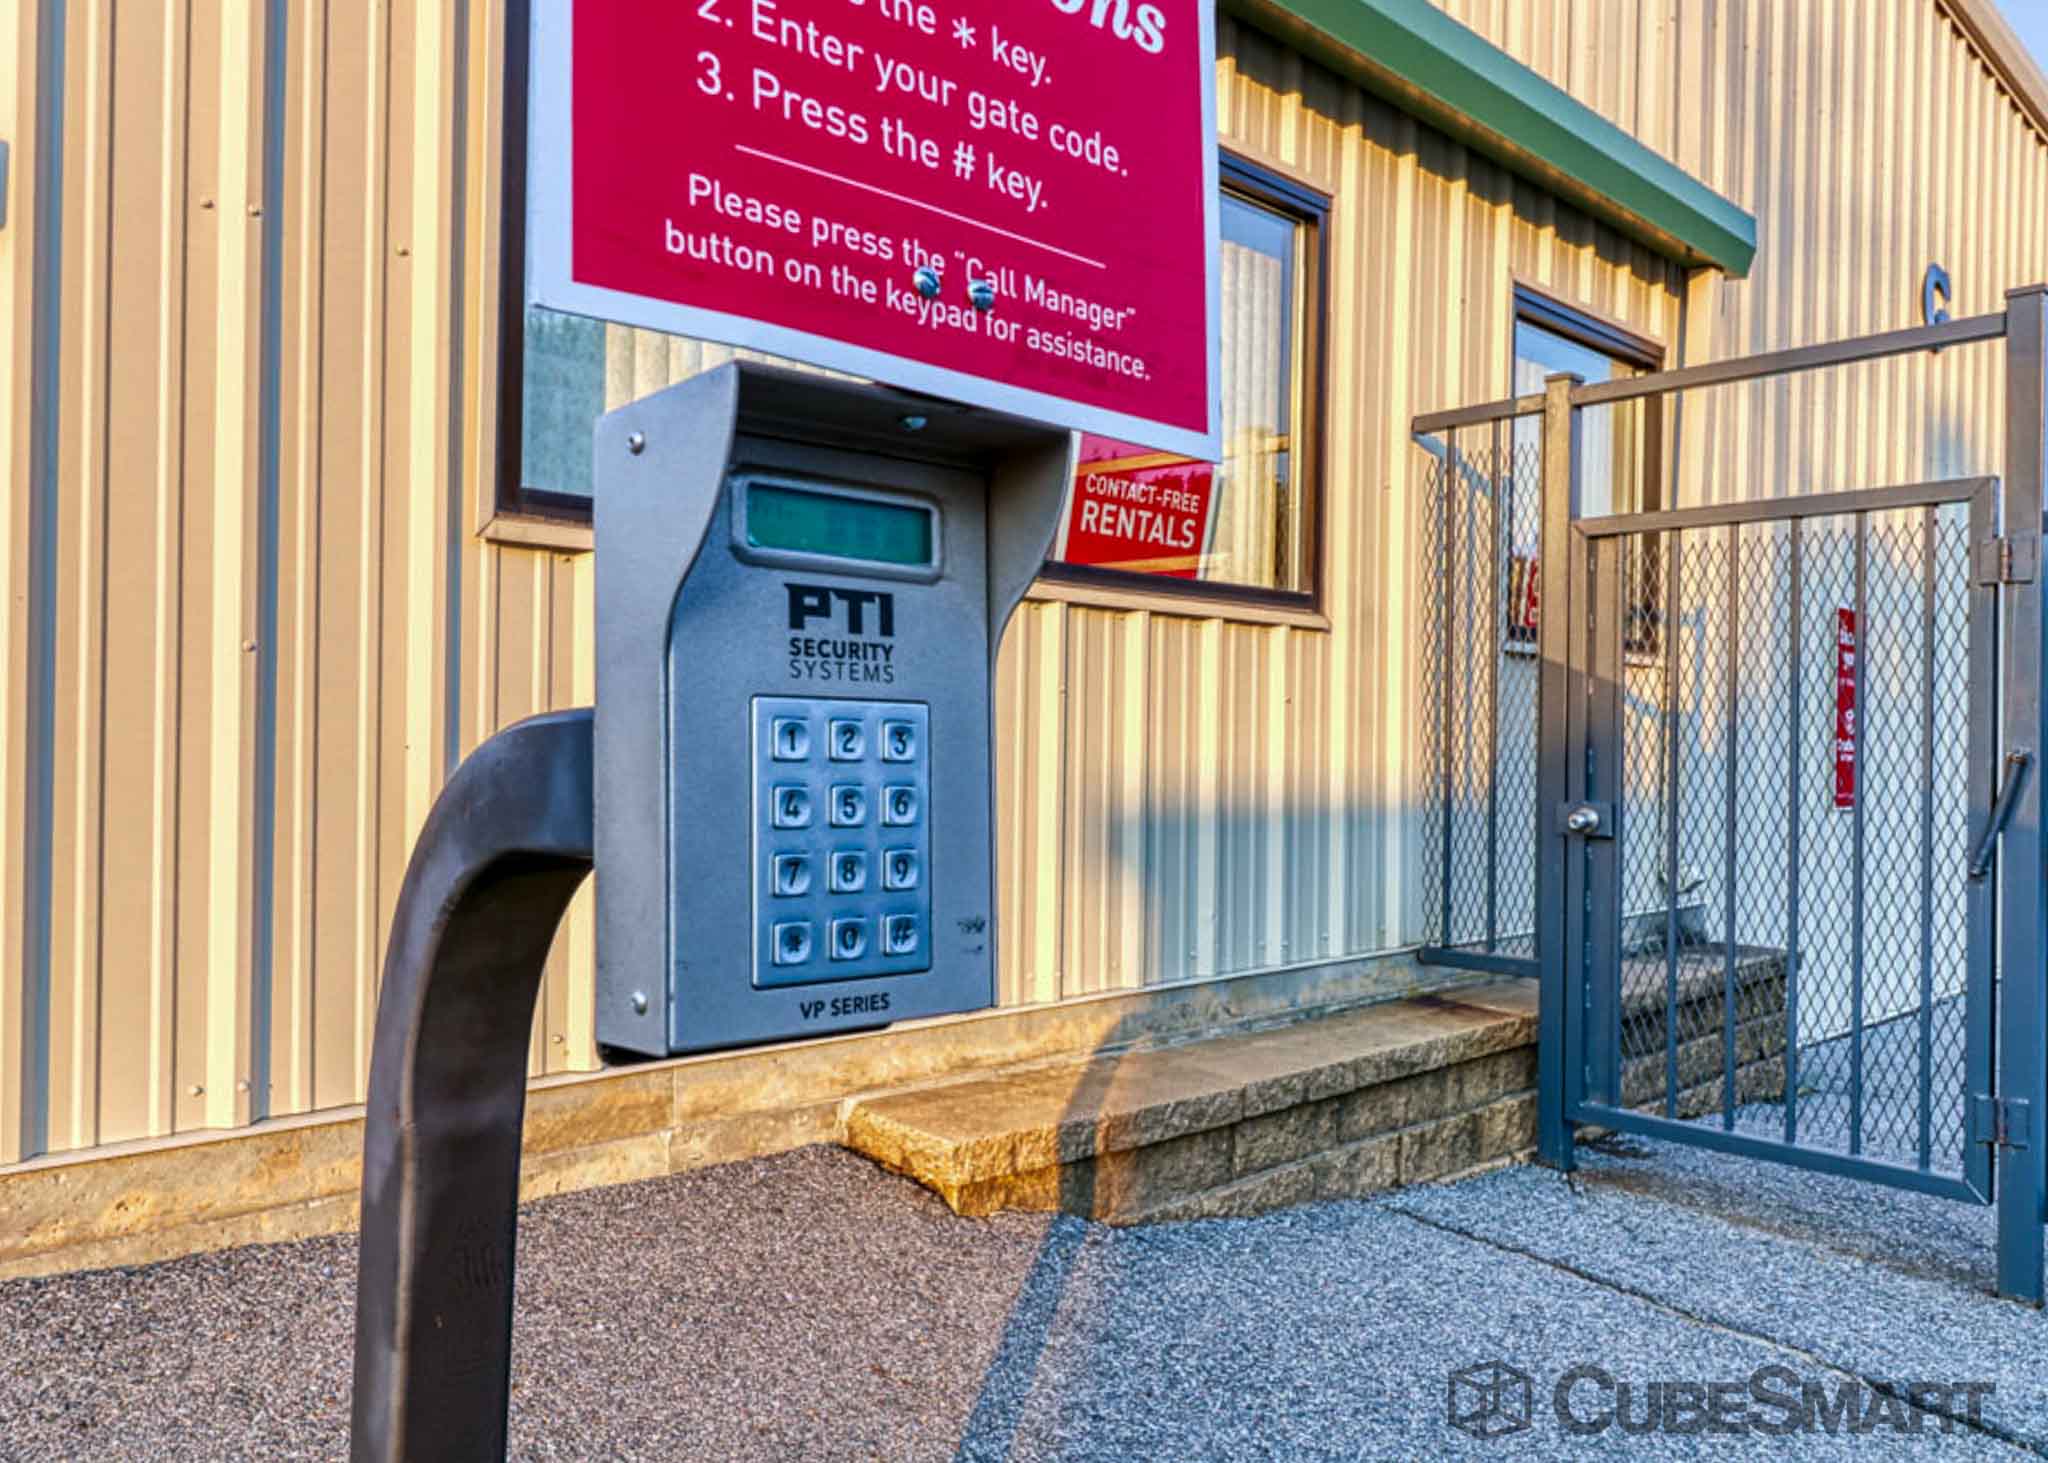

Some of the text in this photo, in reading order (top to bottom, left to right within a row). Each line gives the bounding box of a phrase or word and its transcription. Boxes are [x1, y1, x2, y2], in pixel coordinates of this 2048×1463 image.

[1051, 0, 1166, 54] ns
[992, 25, 1052, 87] key.
[752, 0, 864, 73] Enter
[874, 52, 957, 107] your
[967, 91, 1039, 140] gate
[1050, 124, 1128, 177] code.
[697, 50, 1049, 213] 3. Press the # key.
[689, 172, 802, 234] Please
[811, 215, 894, 261] press
[902, 237, 946, 276] the
[665, 218, 1152, 382] button on the keypad for assistance.
[1085, 472, 1201, 515] CONTACT-FREE
[1080, 498, 1197, 549] RENTALS
[784, 582, 895, 637] PTI
[789, 637, 895, 663] SECURITY
[790, 659, 895, 684] SYSTEMS
[841, 727, 857, 753] 2
[893, 729, 908, 755] 3
[784, 791, 910, 819] 4 5 6
[787, 857, 910, 888] 7 8 9
[842, 926, 860, 951] 0
[800, 992, 891, 1020] VP SERIES
